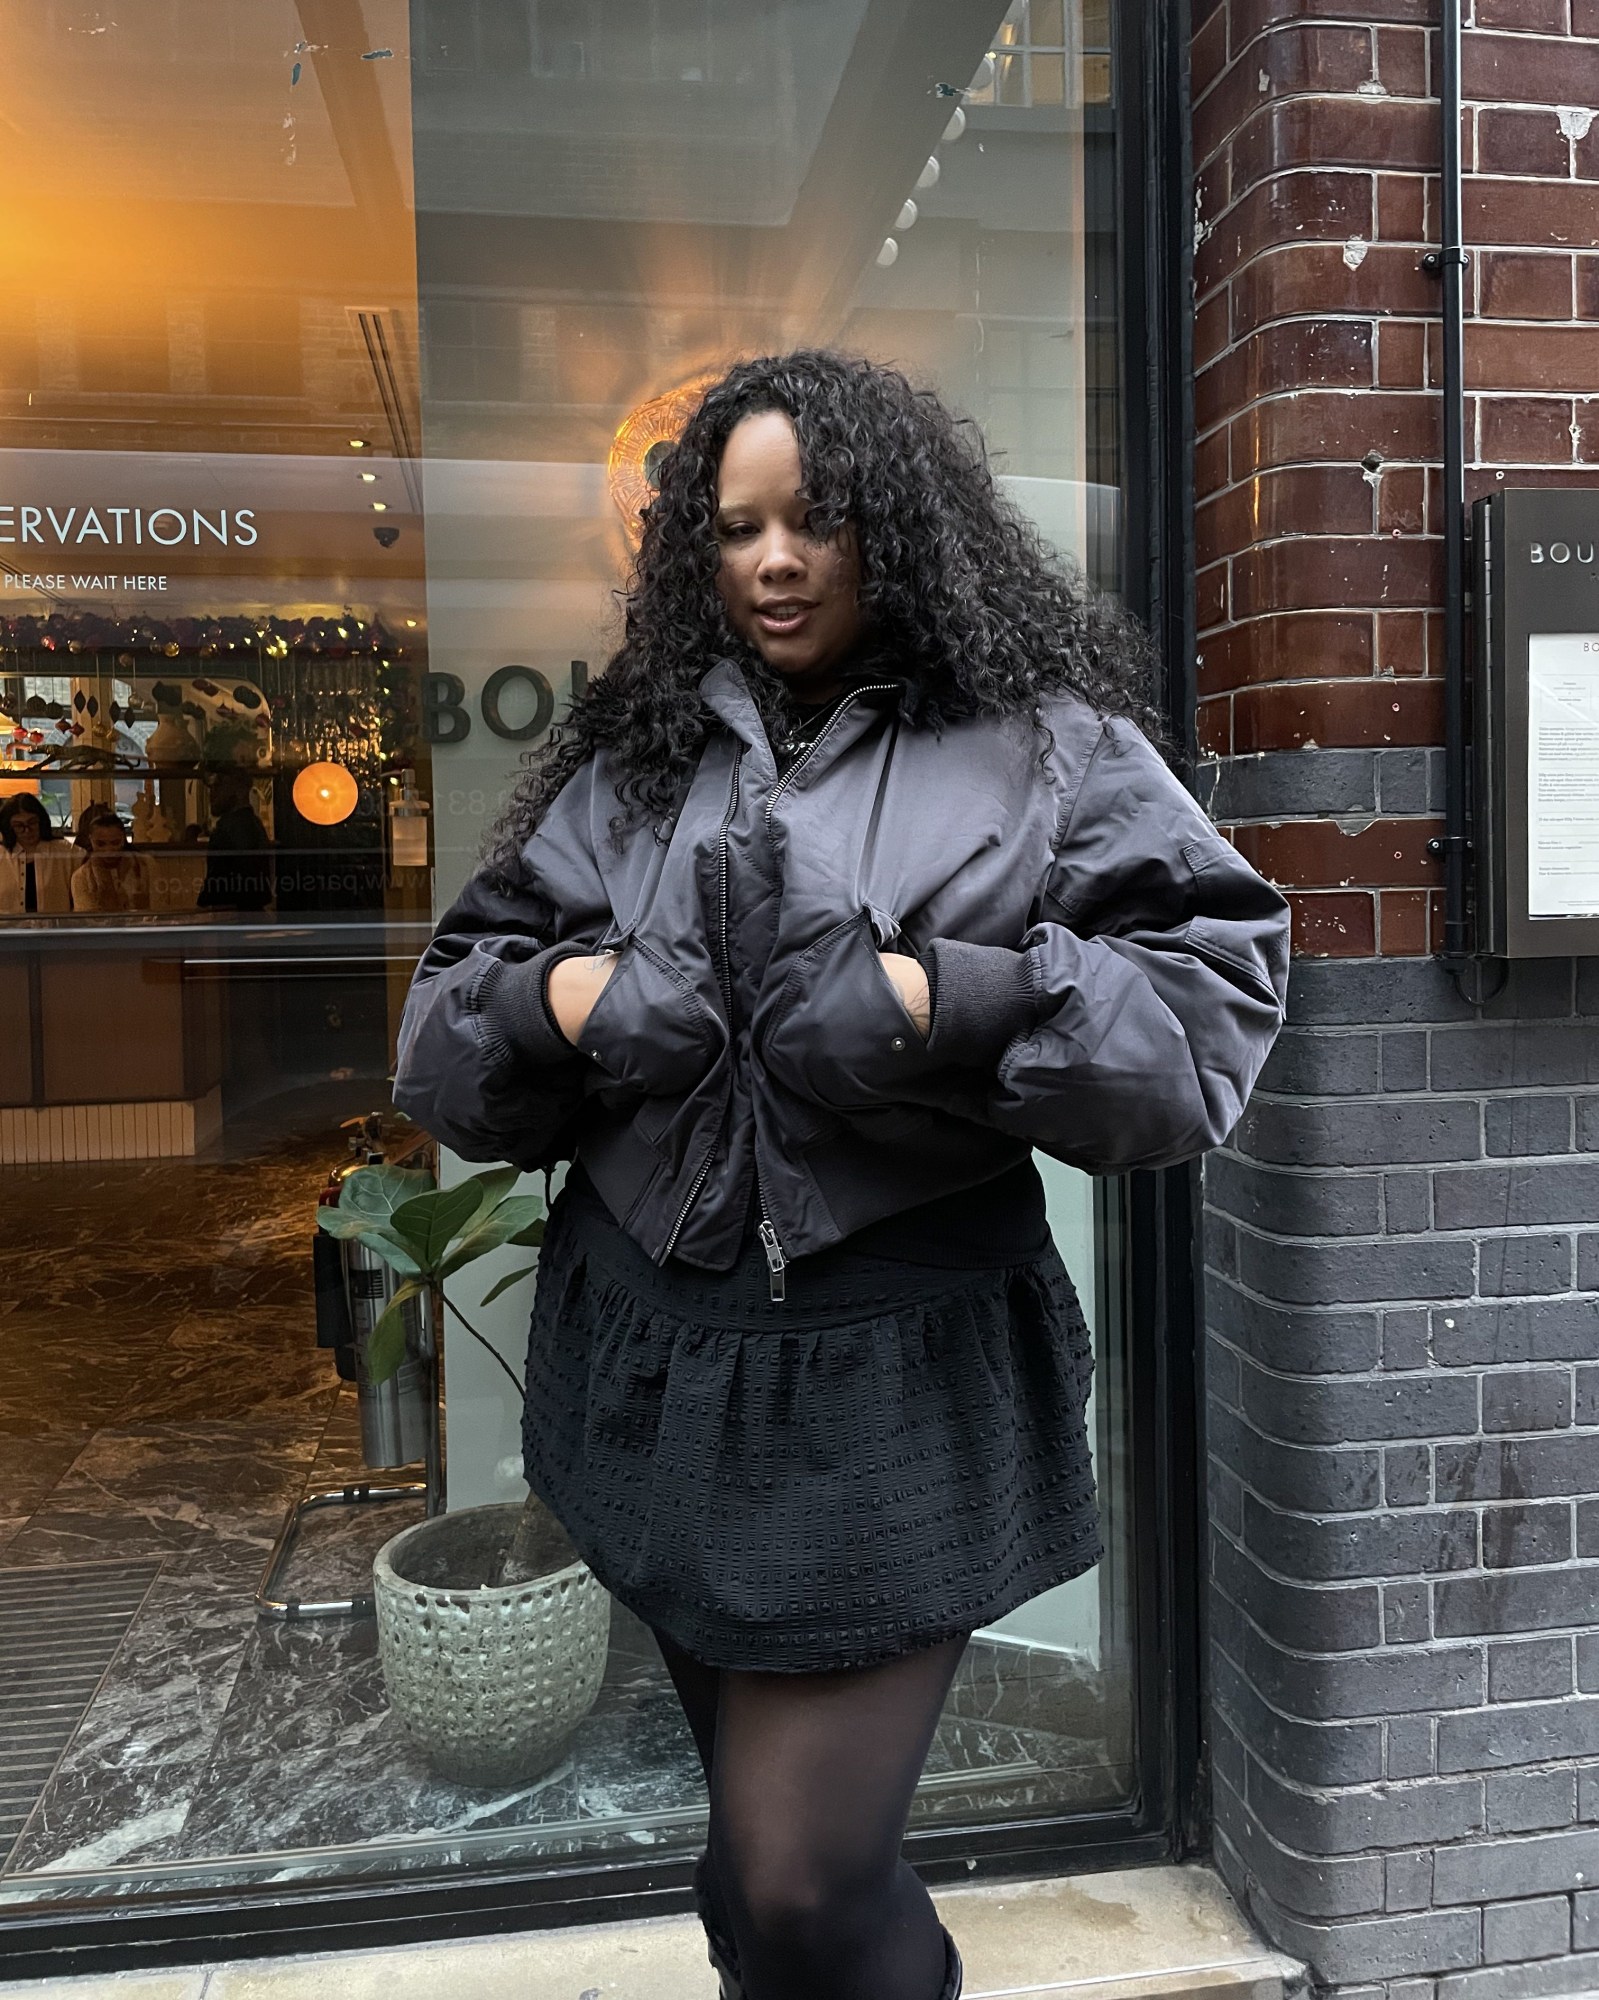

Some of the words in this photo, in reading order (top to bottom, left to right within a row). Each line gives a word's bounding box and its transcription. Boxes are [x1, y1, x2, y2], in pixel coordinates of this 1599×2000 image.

[0, 506, 258, 546] ERVATIONS
[1530, 542, 1594, 564] BOU
[4, 574, 66, 590] PLEASE
[71, 575, 118, 591] WAIT
[123, 576, 168, 592] HERE
